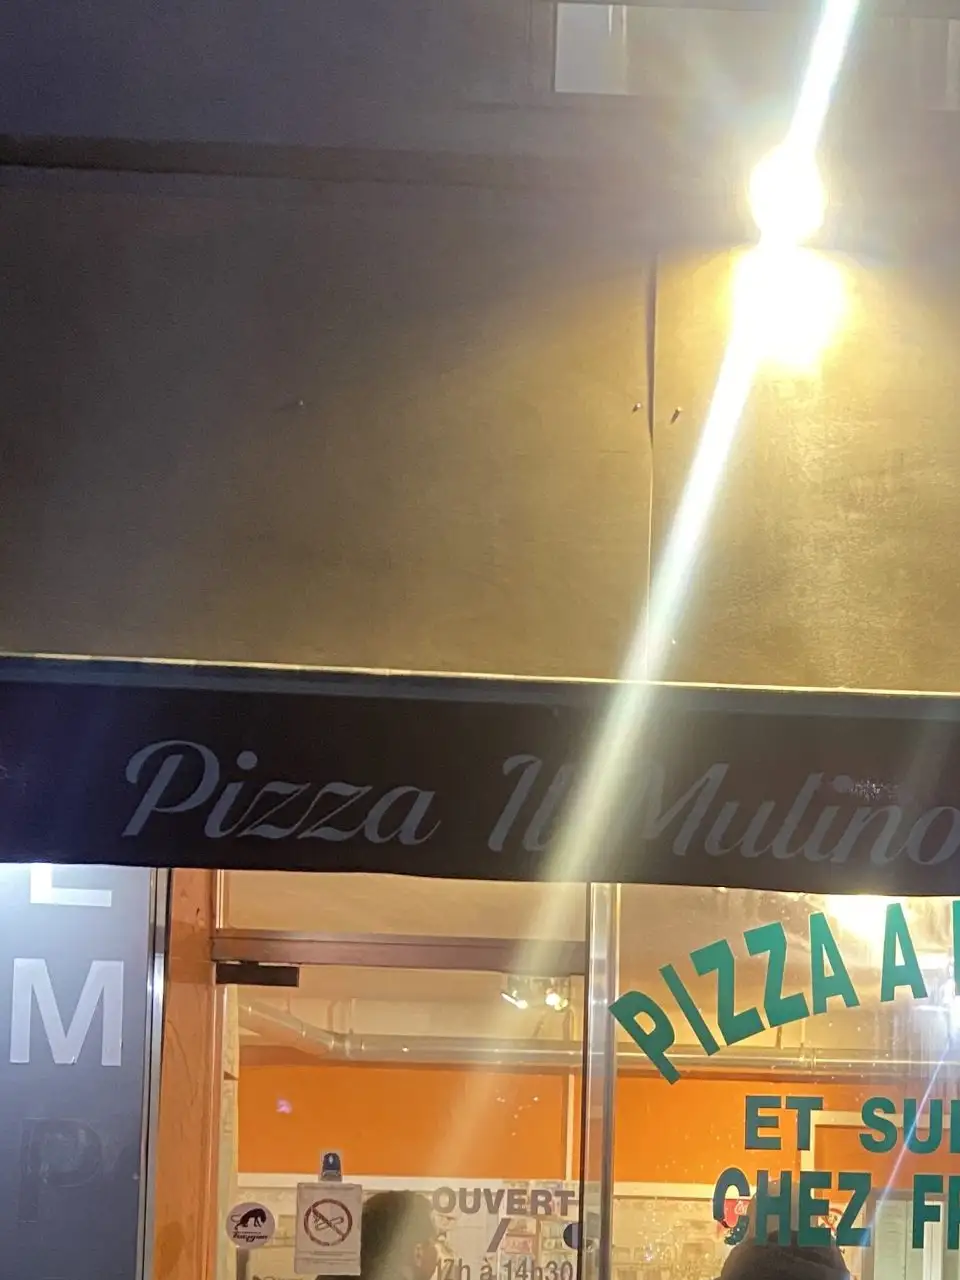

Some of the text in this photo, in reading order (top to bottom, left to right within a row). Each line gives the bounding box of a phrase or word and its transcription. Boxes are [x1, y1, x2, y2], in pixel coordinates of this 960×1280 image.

[125, 738, 443, 846] Pizza
[609, 911, 860, 1085] PIZZA
[880, 902, 928, 1003] A
[744, 1096, 824, 1151] ET
[432, 1186, 575, 1217] OUVERT
[713, 1166, 872, 1247] CHEZ
